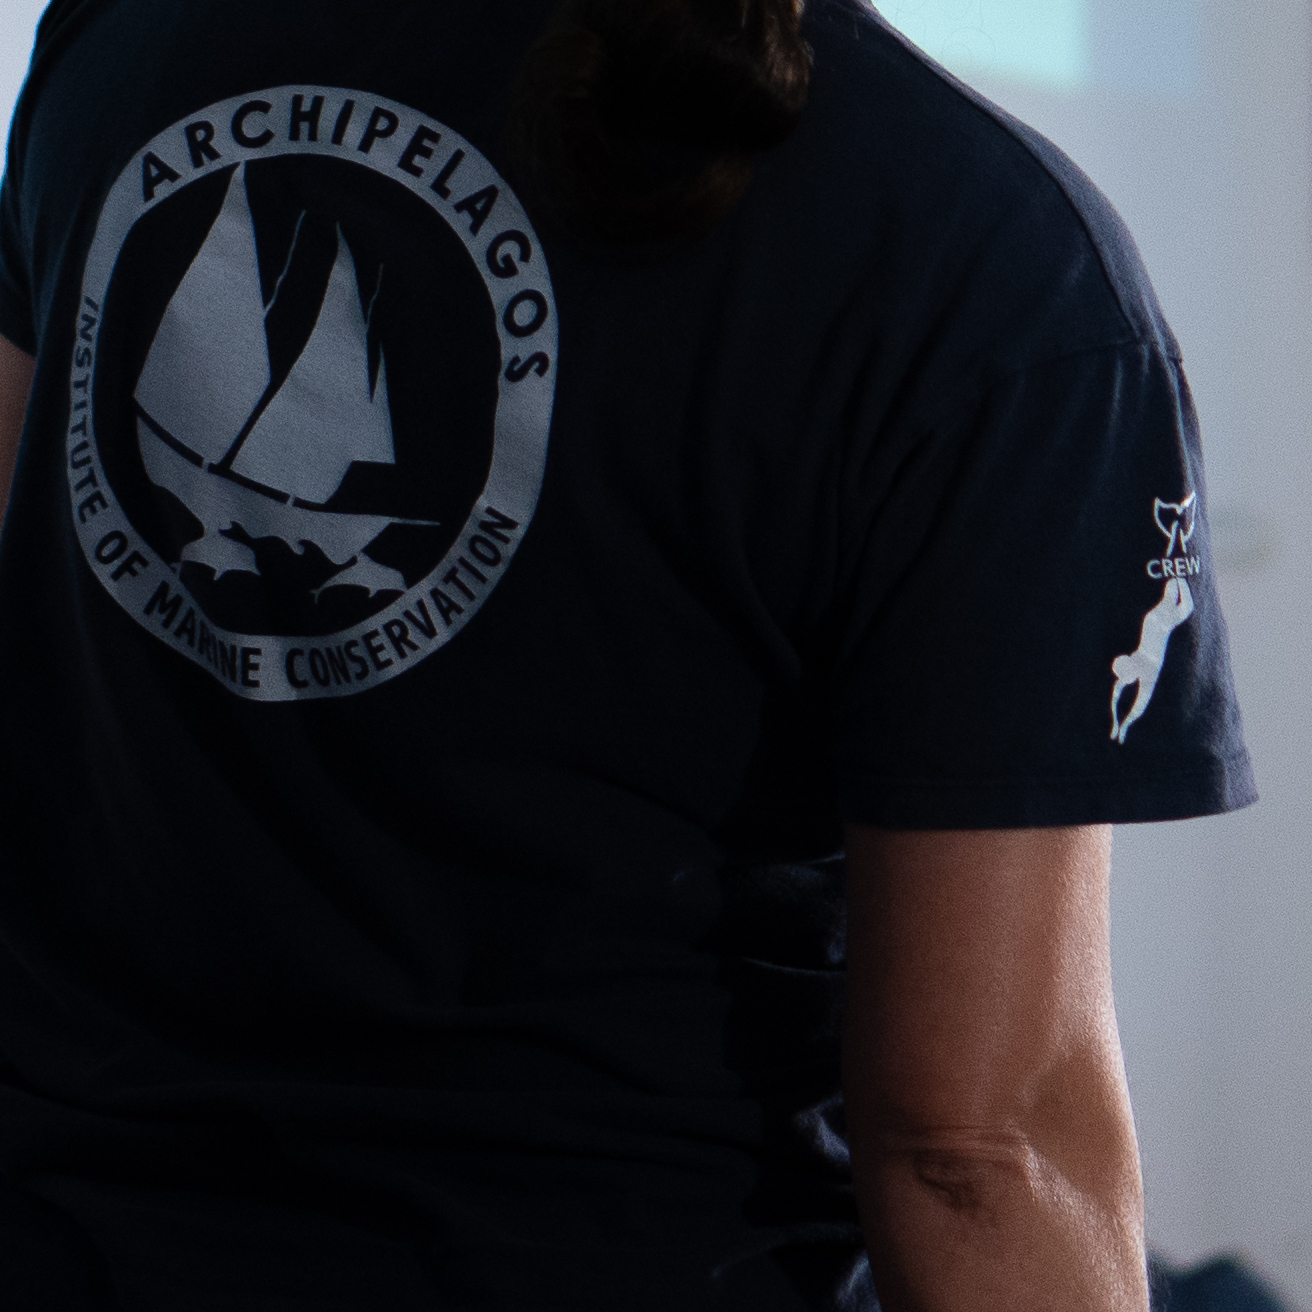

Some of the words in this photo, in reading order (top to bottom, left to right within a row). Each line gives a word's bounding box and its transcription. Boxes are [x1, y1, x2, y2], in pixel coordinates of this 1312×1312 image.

[140, 94, 551, 385] ARCHIPELAGOS
[68, 296, 109, 524] INSTITUTE
[94, 529, 148, 583] OF
[142, 582, 263, 689] MARINE
[286, 505, 521, 690] CONSERVATION
[1146, 555, 1200, 579] CREW
